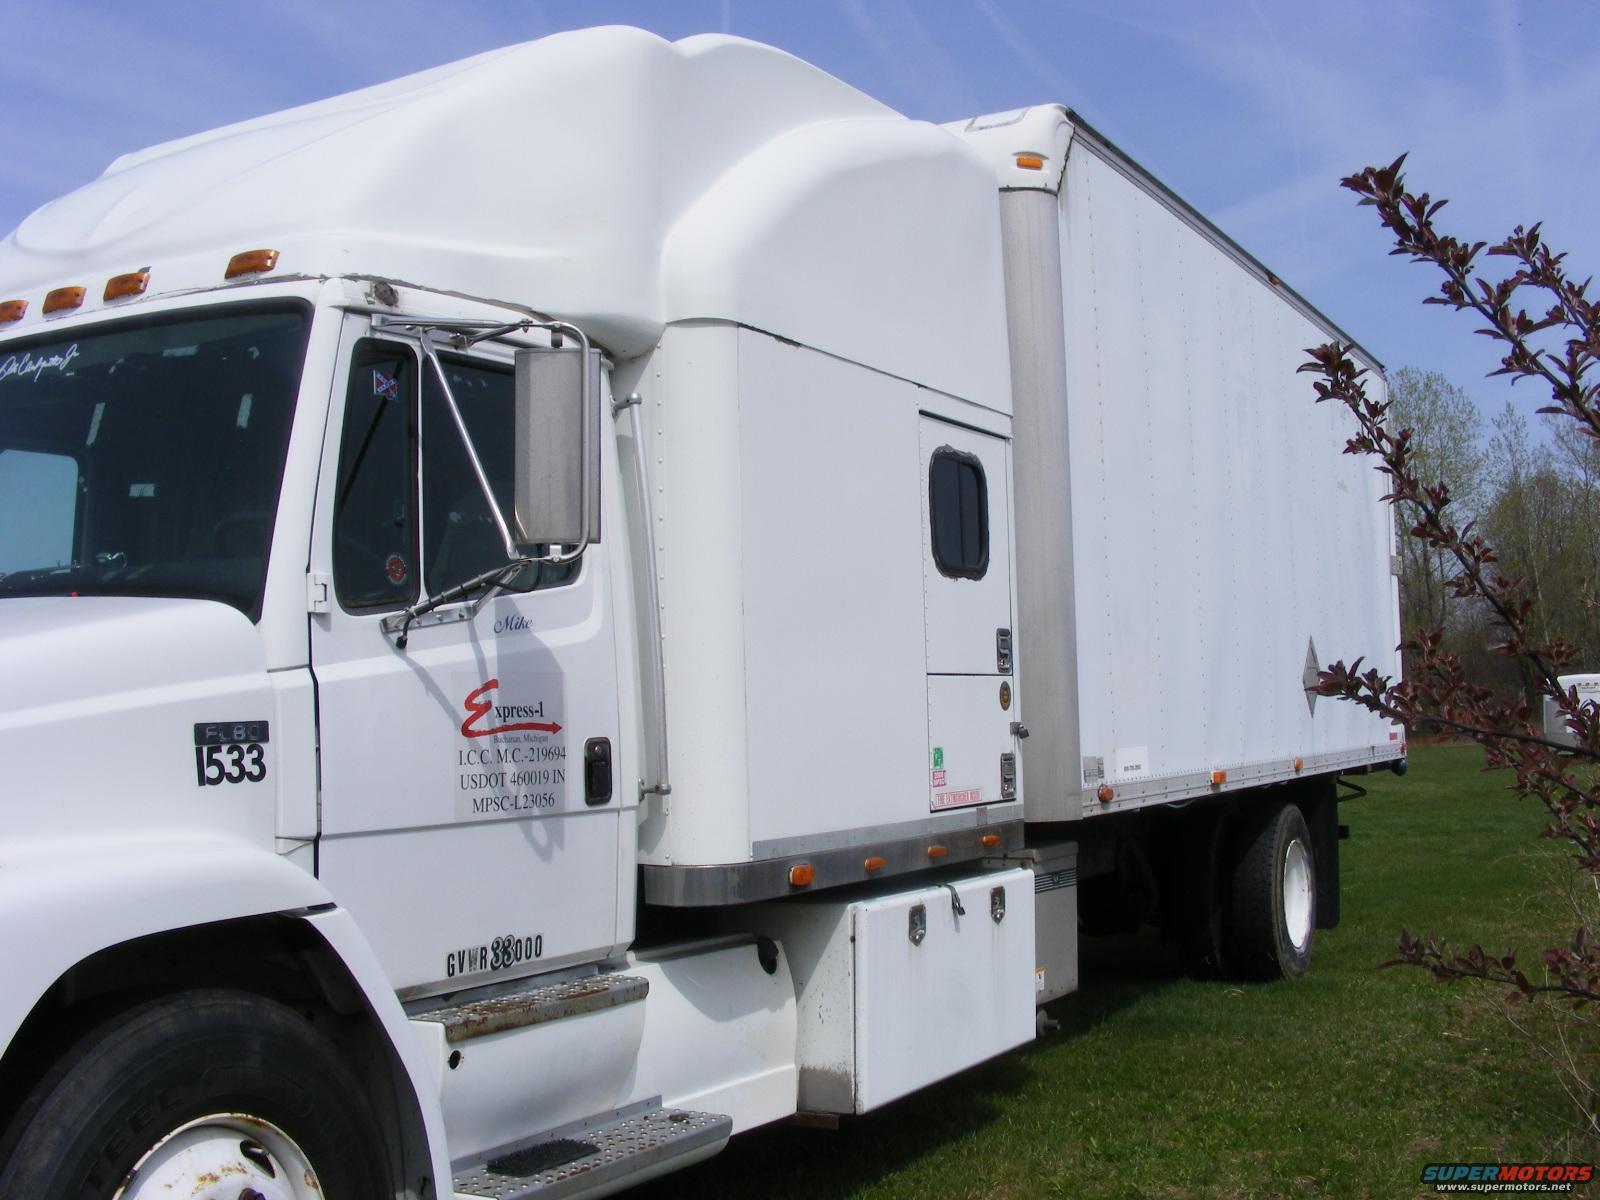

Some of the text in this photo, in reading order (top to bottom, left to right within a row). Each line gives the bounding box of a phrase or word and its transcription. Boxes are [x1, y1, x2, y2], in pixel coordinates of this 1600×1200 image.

[493, 615, 533, 634] Mike
[195, 743, 267, 787] 1533
[459, 749, 493, 766] I.C.C.
[460, 768, 566, 790] USDOT 460019 IN
[472, 792, 555, 814] MPSC-L23056
